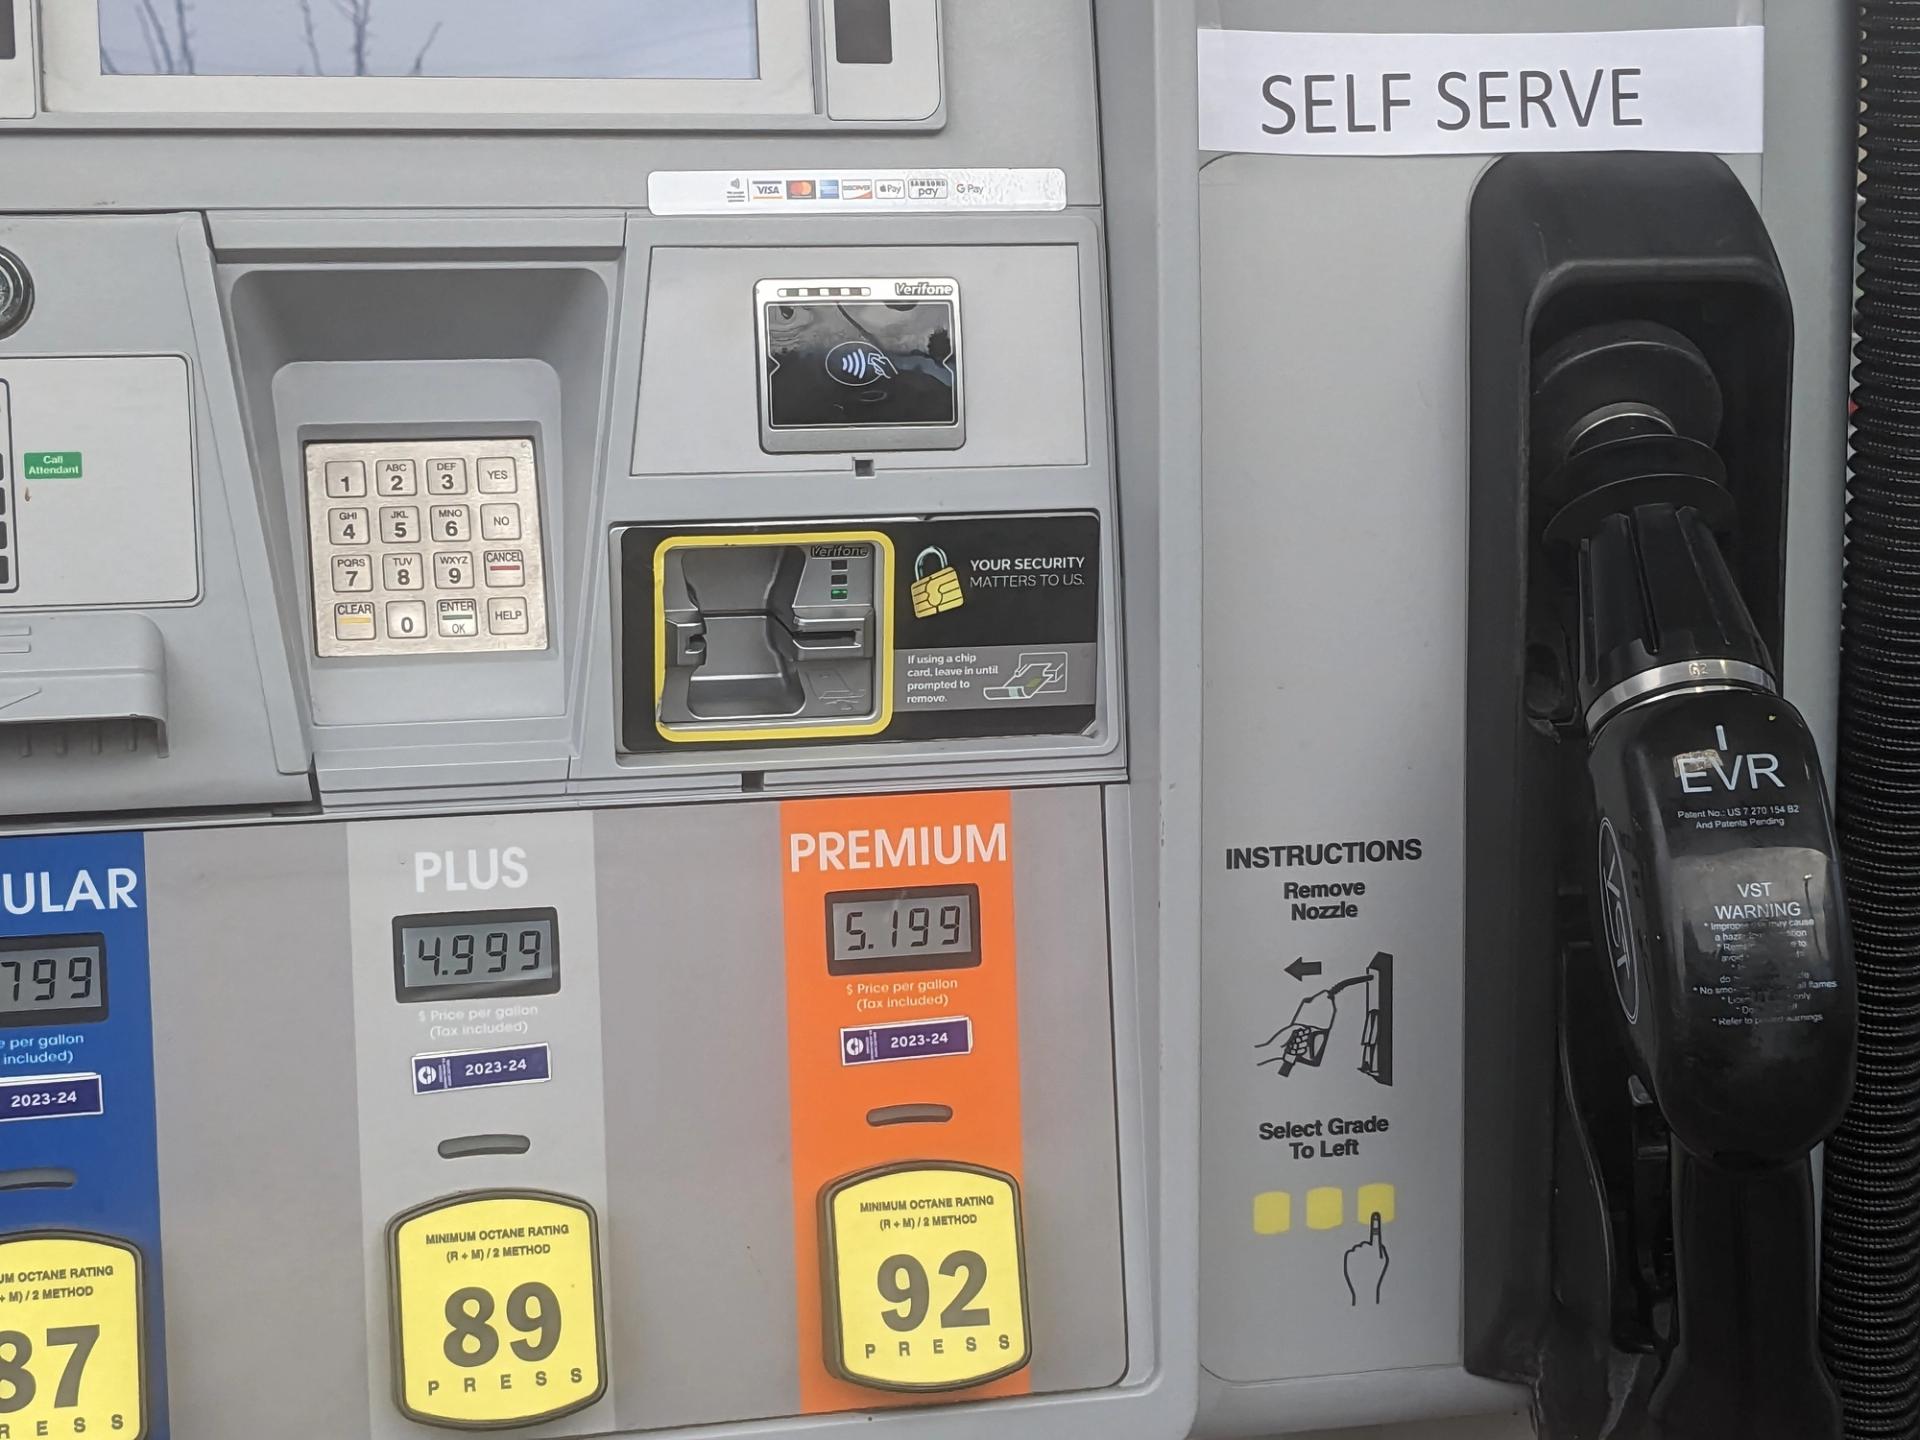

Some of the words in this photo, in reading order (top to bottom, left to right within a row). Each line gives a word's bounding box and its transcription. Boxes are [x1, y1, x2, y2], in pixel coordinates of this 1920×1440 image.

[1261, 72, 1411, 135] SELF
[1436, 68, 1643, 132] SERVE
[757, 186, 779, 194] VISA
[887, 184, 901, 194] Pay
[919, 188, 938, 198] pay
[968, 184, 984, 194] Pay
[895, 282, 953, 296] Verifone
[43, 455, 64, 464] Call
[385, 463, 407, 472] ABC
[436, 462, 457, 471] DEF
[28, 465, 79, 475] Attendant
[486, 470, 508, 480] YES
[341, 476, 350, 492] 1
[390, 475, 403, 491] 2
[441, 474, 454, 490] 3
[339, 512, 357, 521] GHI
[390, 510, 409, 519] JKL
[438, 509, 462, 518] MNO
[493, 516, 510, 526] NO
[342, 523, 355, 540] 4
[394, 522, 407, 538] 5
[445, 521, 458, 537] 6
[337, 558, 366, 567] PQRS
[392, 557, 413, 567] TUV
[439, 555, 469, 565] WXYZ
[486, 552, 523, 563] CANCEL
[970, 559, 1011, 571] YOUR
[1014, 556, 1085, 570] SECURITY
[345, 570, 358, 587] 7
[397, 569, 410, 586] 8
[448, 568, 461, 584] 9
[970, 575, 1036, 588] MATTERS
[1040, 575, 1059, 586] TO
[1063, 573, 1085, 586] US.
[337, 604, 372, 615] CLEAR
[439, 601, 474, 612] ENTER
[495, 610, 522, 620] HELP
[400, 617, 414, 633] 0
[451, 623, 466, 634] OK
[907, 655, 916, 664] If
[917, 655, 945, 666] using
[946, 656, 953, 664] a
[955, 653, 977, 664] chip
[935, 667, 963, 676] leave
[964, 666, 974, 675] in
[976, 665, 999, 675] until
[907, 680, 957, 691] prompted
[959, 679, 970, 688] to
[907, 694, 948, 703] remove.
[1677, 752, 1785, 793] EVR
[1677, 810, 1706, 819] Patent
[1727, 807, 1741, 817] US
[1743, 807, 1749, 815] 7
[1751, 806, 1767, 815] 270
[1770, 805, 1785, 814] 154
[1787, 804, 1800, 813] B2
[1696, 821, 1713, 829] And
[1715, 820, 1748, 829] Patents
[1749, 817, 1785, 827] Pending
[790, 823, 1007, 873] PREMIUM
[1226, 838, 1423, 870] INSTRUCTIONS
[414, 847, 528, 892] PLUS
[1284, 881, 1366, 900] Remove
[1737, 882, 1773, 898] VST
[1292, 901, 1358, 921] Nozzle
[1714, 901, 1801, 920] WARNING
[846, 905, 961, 951] 5.199
[418, 930, 541, 976] 4.999
[846, 983, 853, 995] $
[857, 982, 889, 994] Price
[893, 981, 914, 995] per
[918, 979, 958, 994] gallon
[1700, 987, 1713, 995] No
[857, 997, 883, 1012] (Tax
[887, 994, 950, 1009] included)
[418, 1009, 426, 1022] $
[431, 1009, 465, 1021] Price
[469, 1008, 491, 1022] per
[496, 1005, 539, 1022] gallon
[430, 1024, 459, 1040] (Tax
[462, 1021, 528, 1037] included)
[10, 1038, 34, 1050] per
[39, 1033, 85, 1050] gallon
[891, 1032, 949, 1049] 2023-24
[3, 1049, 74, 1065] included)
[465, 1058, 527, 1076] 2023-24
[10, 1091, 77, 1108] 2023-24
[1259, 1119, 1323, 1140] Select
[1328, 1115, 1389, 1135] Grade
[1289, 1141, 1315, 1159] To
[1320, 1138, 1359, 1157] Left
[860, 1199, 907, 1213] MINIMUM
[910, 1197, 953, 1210] OCTANE
[955, 1194, 994, 1207] RATING
[880, 1219, 891, 1232] (R
[903, 1218, 915, 1231] M)
[924, 1217, 930, 1227] 2
[932, 1213, 977, 1227] METHOD
[426, 1230, 476, 1245] MINIMUM
[479, 1227, 525, 1241] OCTANE
[528, 1224, 569, 1237] RATING
[446, 1250, 459, 1263] (R
[471, 1249, 485, 1262] M)
[493, 1247, 500, 1258] 2
[502, 1244, 551, 1258] METHOD
[18, 1269, 66, 1283] OCTANE
[70, 1265, 114, 1279] RATING
[9, 1291, 23, 1304] M)
[32, 1290, 39, 1300] 2
[42, 1286, 94, 1300] METHOD
[877, 1249, 991, 1333] 92
[443, 1281, 562, 1368] 89
[0, 1323, 100, 1413] 87
